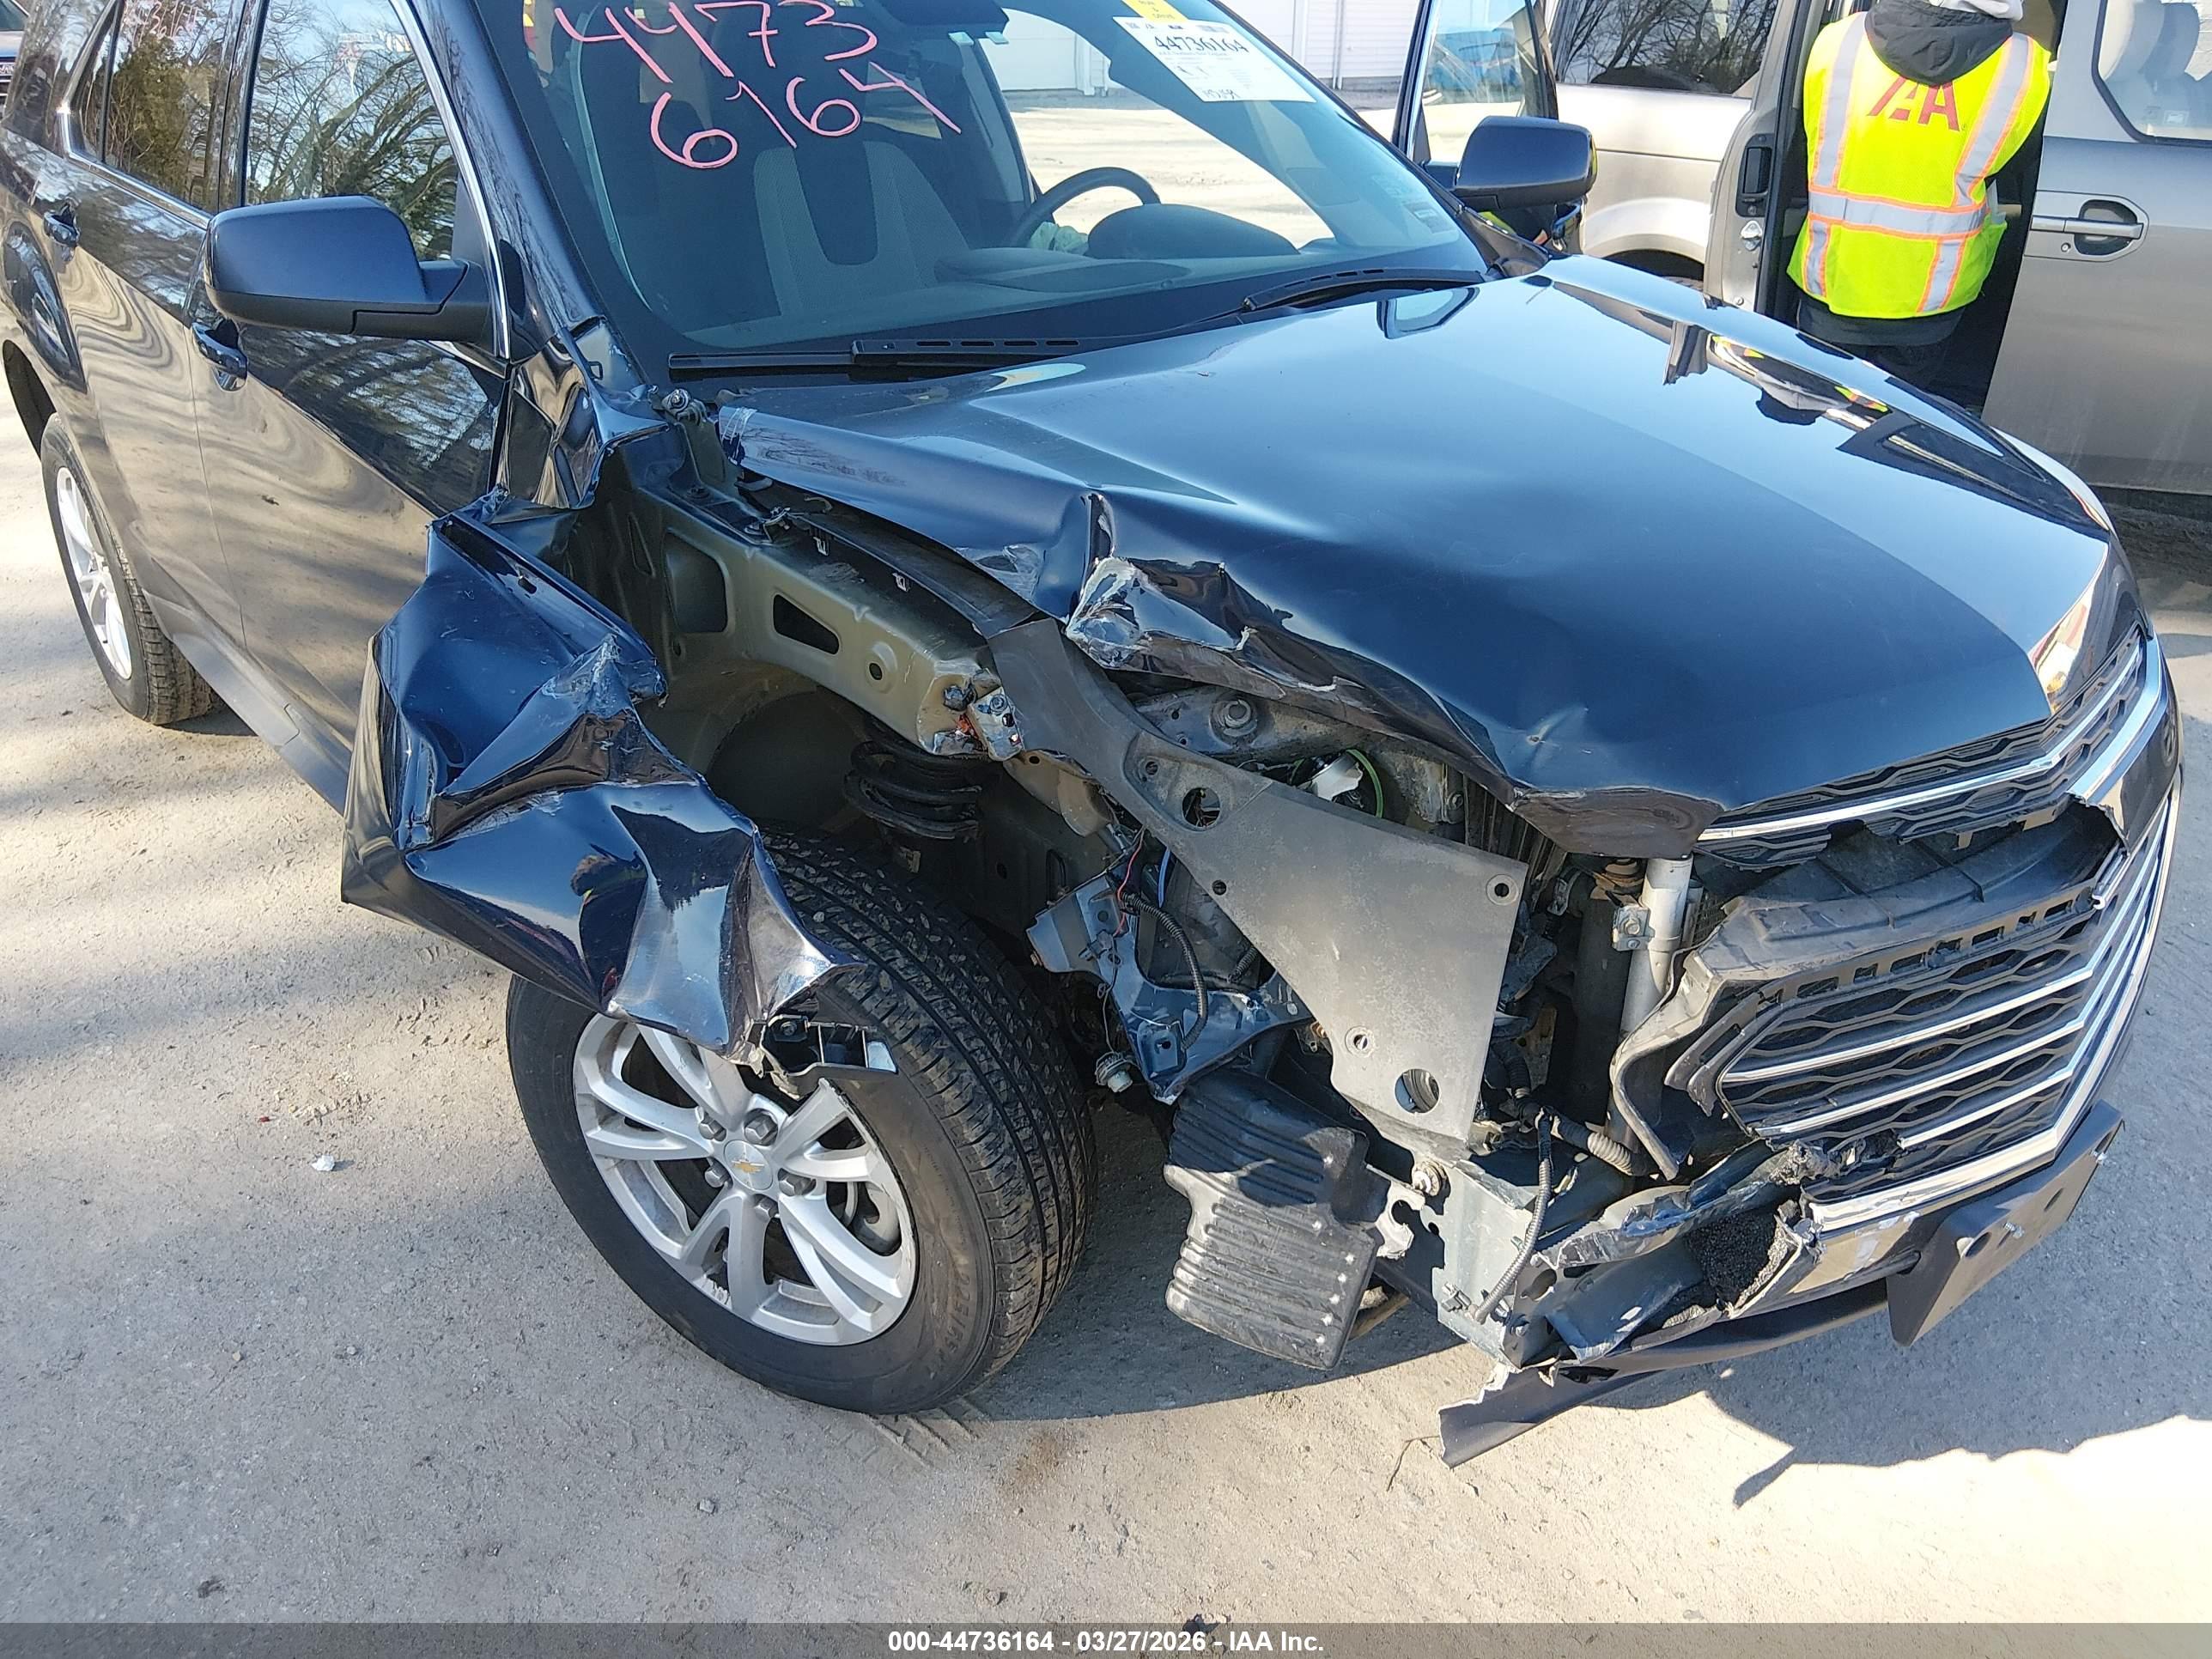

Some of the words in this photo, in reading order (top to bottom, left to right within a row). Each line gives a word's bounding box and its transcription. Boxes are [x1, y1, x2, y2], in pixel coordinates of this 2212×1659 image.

[555, 0, 878, 83] 4473
[1154, 35, 1249, 53] 44736164
[649, 61, 962, 168] 6164
